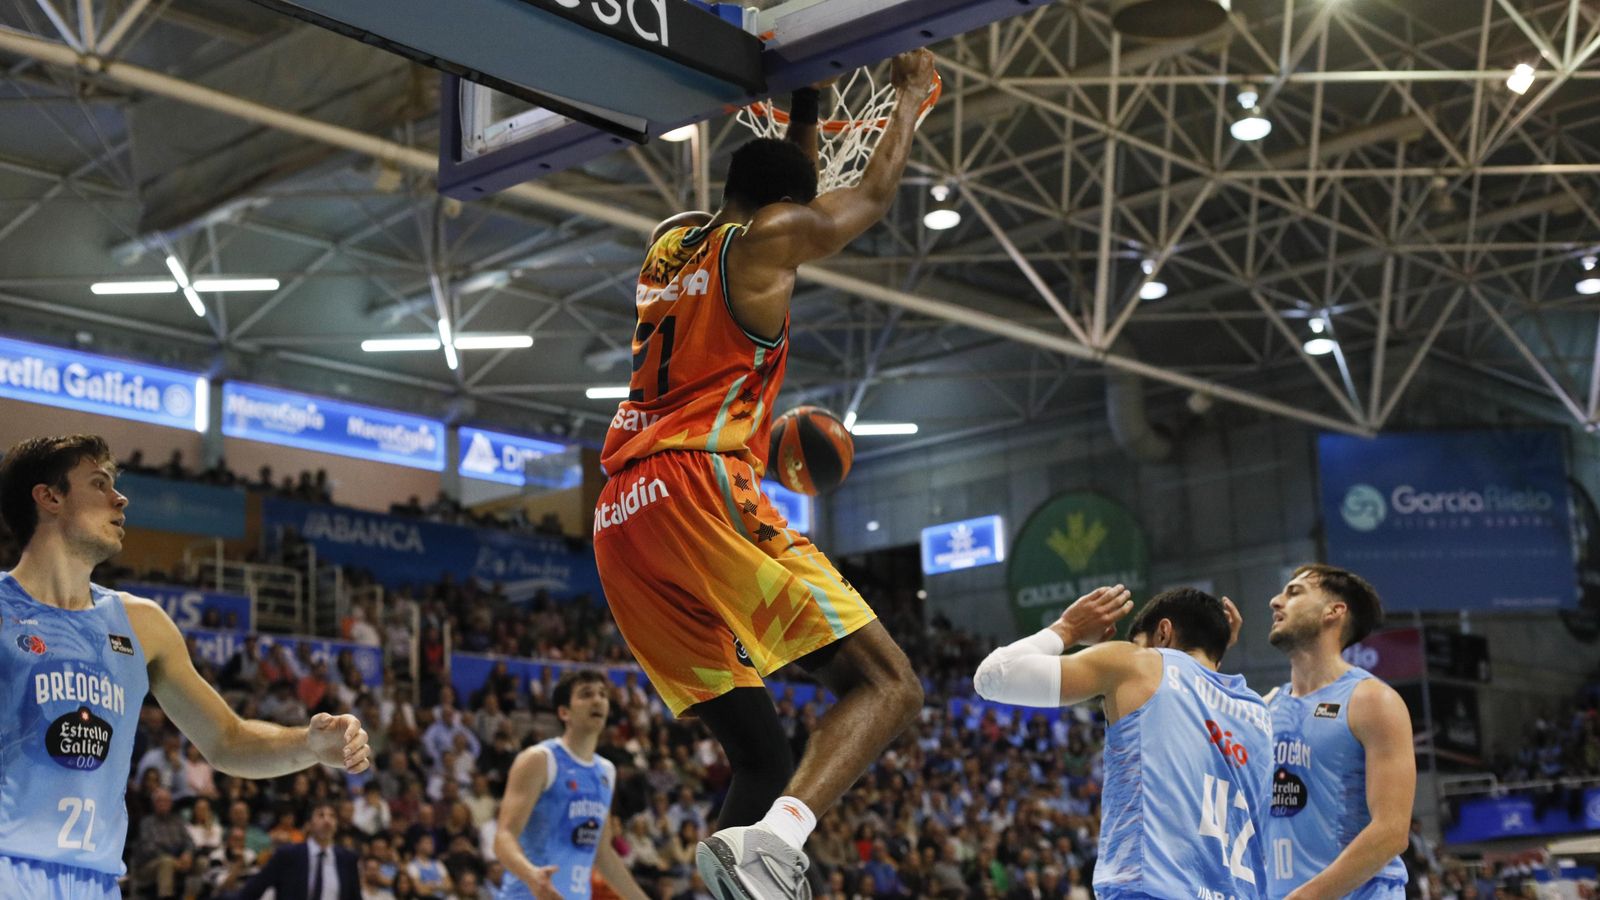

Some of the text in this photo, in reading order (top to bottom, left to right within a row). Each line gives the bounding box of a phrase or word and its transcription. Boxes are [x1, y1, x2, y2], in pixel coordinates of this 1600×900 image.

[63, 362, 161, 412] Galicia
[594, 476, 671, 537] ntaldin
[60, 721, 108, 743] Estrella
[60, 738, 104, 757] Galicia
[1272, 782, 1300, 795] trella
[57, 796, 97, 853] 22
[1199, 773, 1256, 885] 42
[1273, 838, 1294, 880] 10
